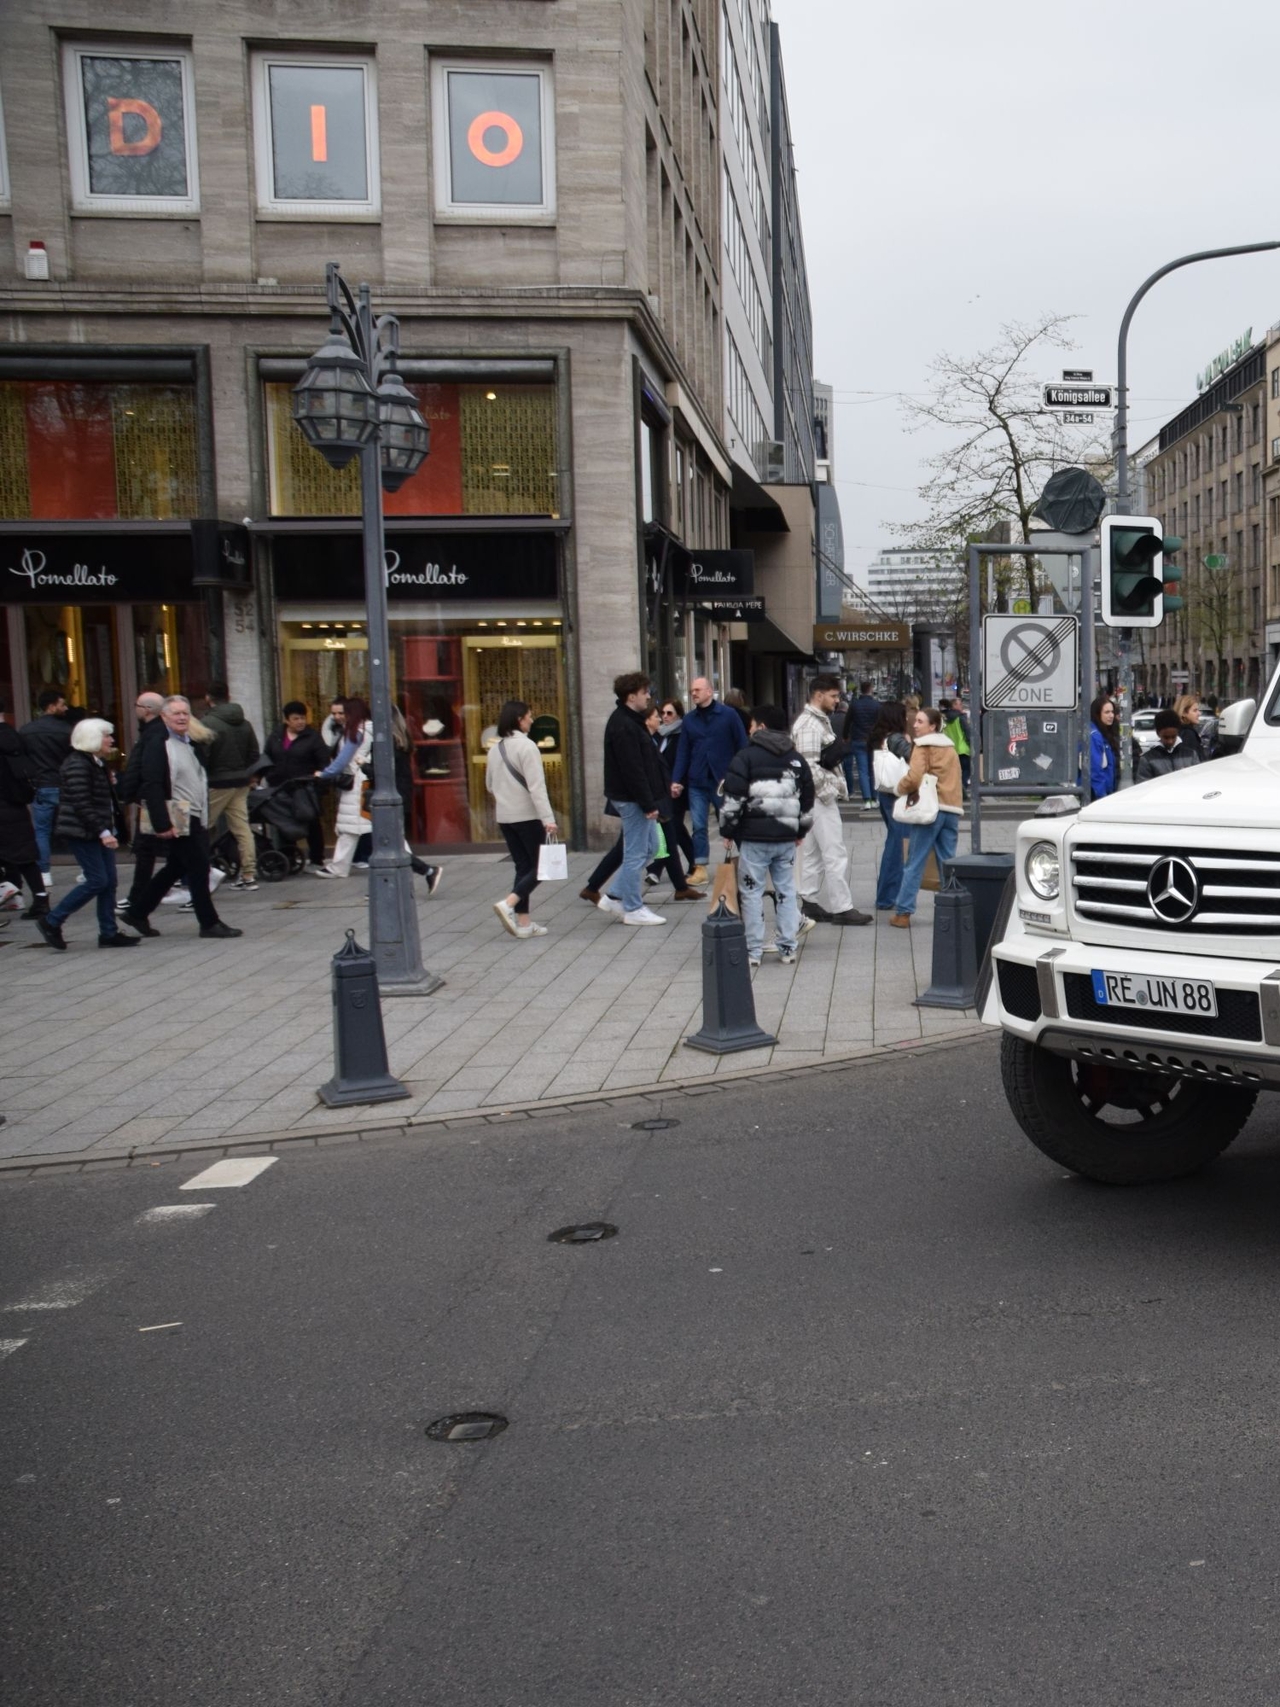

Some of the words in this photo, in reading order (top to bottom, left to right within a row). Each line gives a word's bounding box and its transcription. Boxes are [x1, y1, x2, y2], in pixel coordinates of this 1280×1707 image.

[1051, 389, 1106, 404] Königsallee
[8, 548, 119, 589] Pomellato
[384, 549, 469, 588] Pomellato
[689, 563, 737, 584] Pomellato
[824, 631, 899, 642] C.WIRSCHKE
[1008, 688, 1053, 703] ZONE
[1106, 975, 1136, 1004] RE
[1146, 979, 1178, 1009] UN
[1182, 982, 1212, 1012] 88
